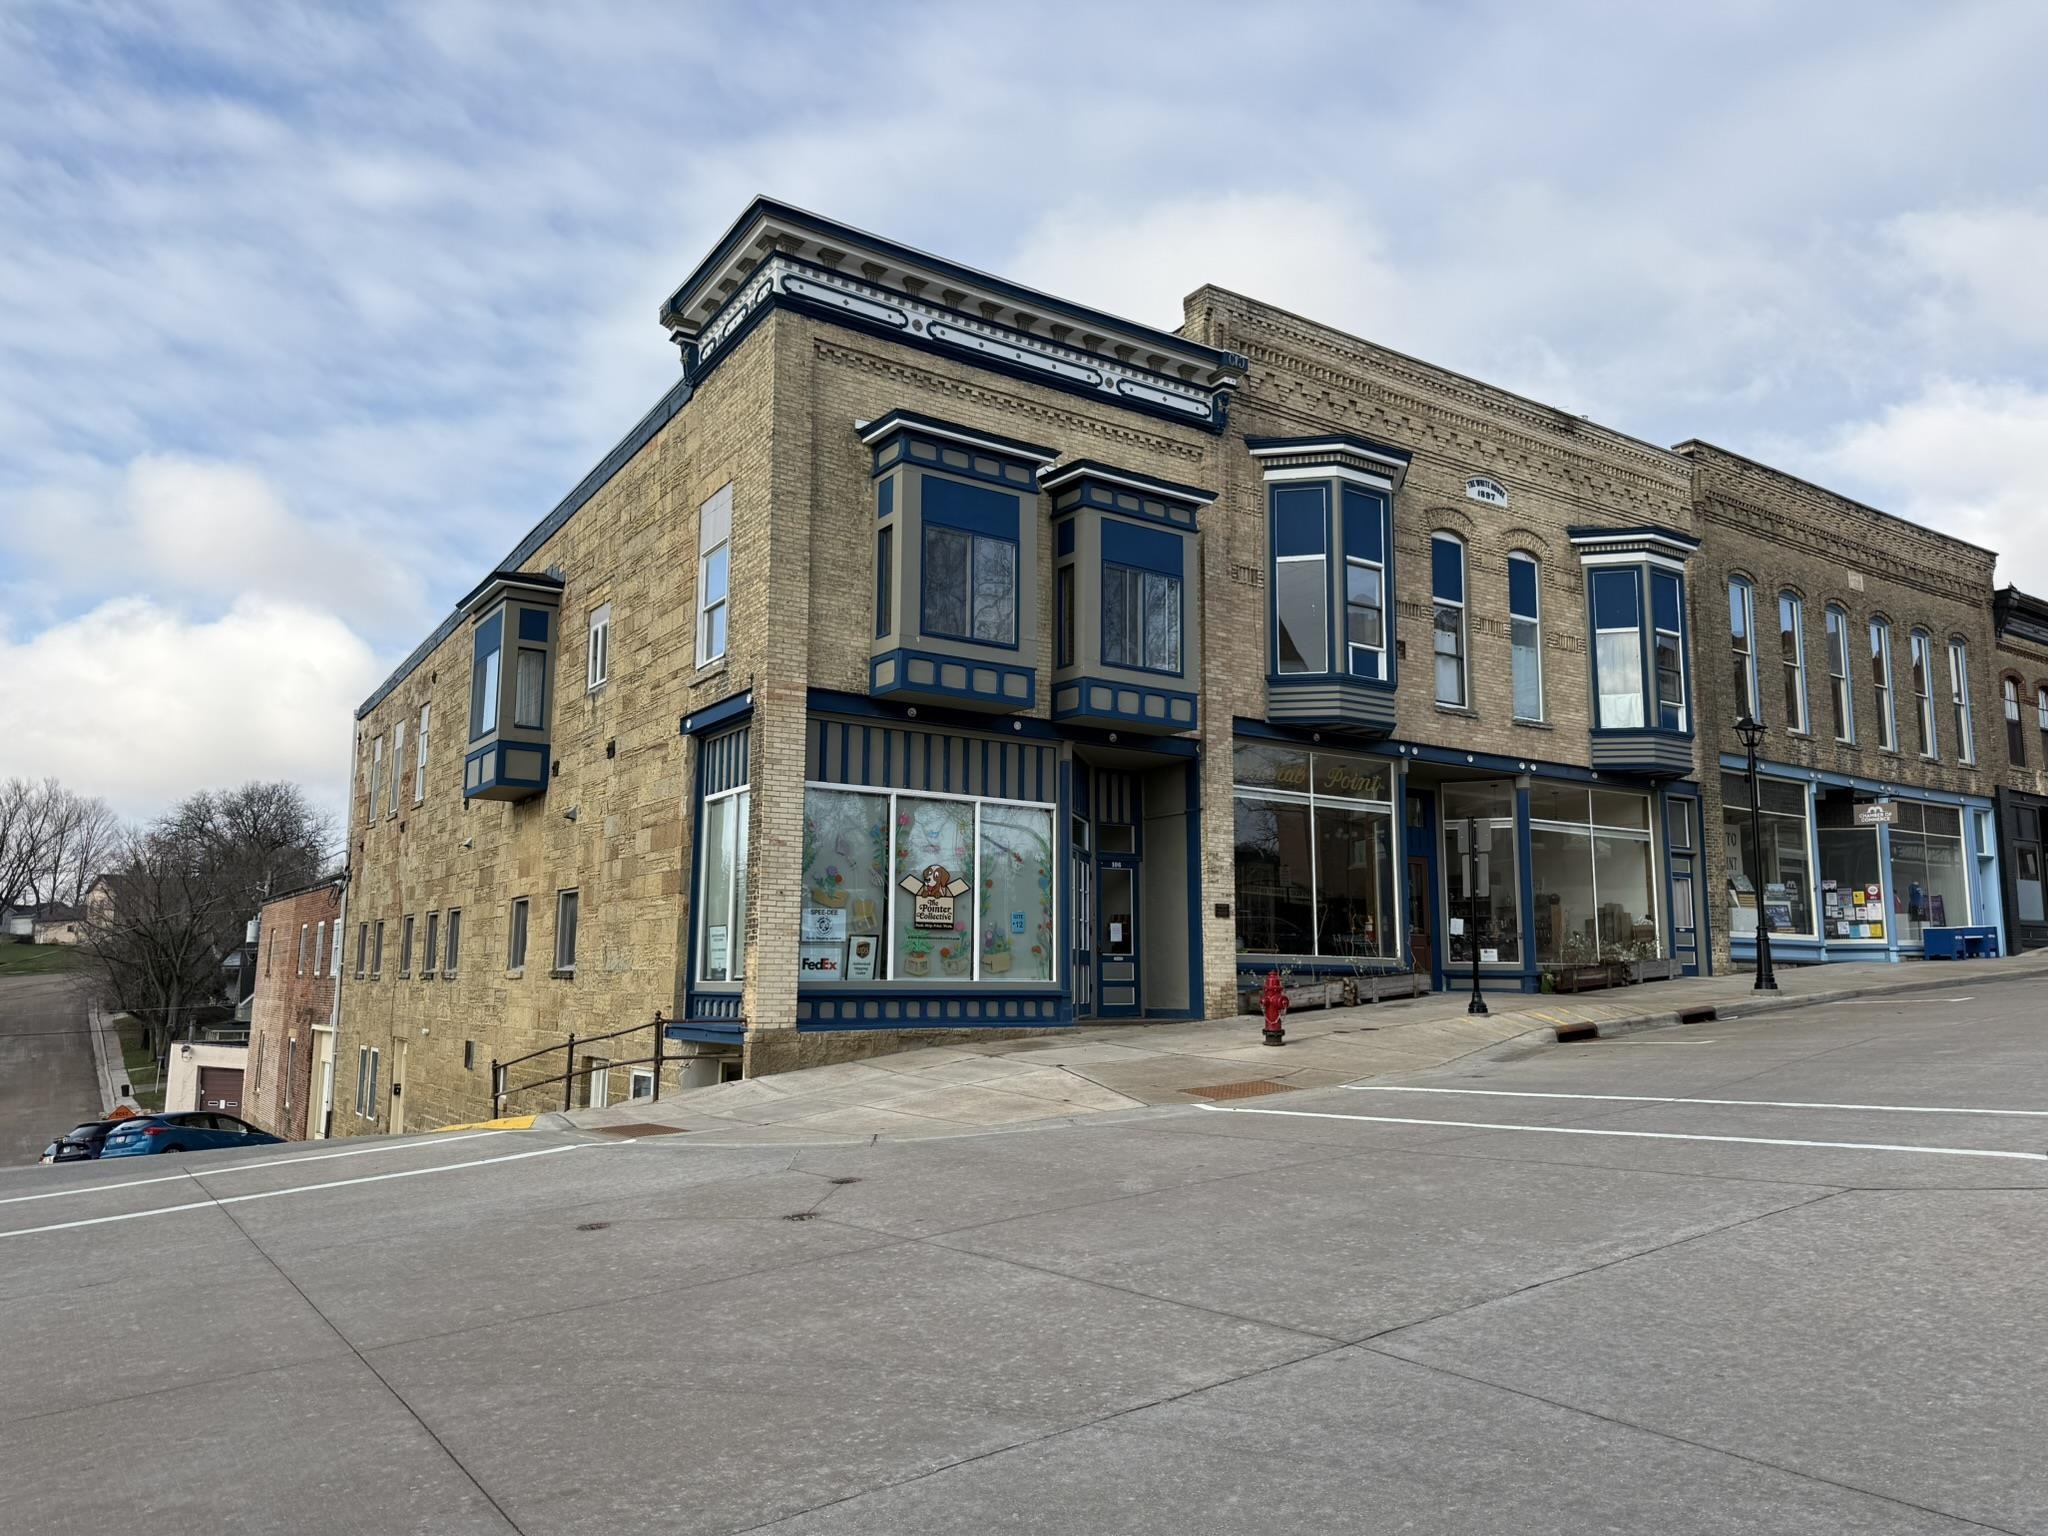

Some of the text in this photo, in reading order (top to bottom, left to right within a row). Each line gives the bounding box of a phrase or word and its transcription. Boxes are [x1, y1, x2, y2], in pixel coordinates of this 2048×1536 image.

[1477, 490, 1495, 501] 1897
[1323, 767, 1385, 792] Point
[919, 904, 952, 913] Pointer
[916, 912, 953, 921] Collective
[802, 957, 837, 970] FedEx
